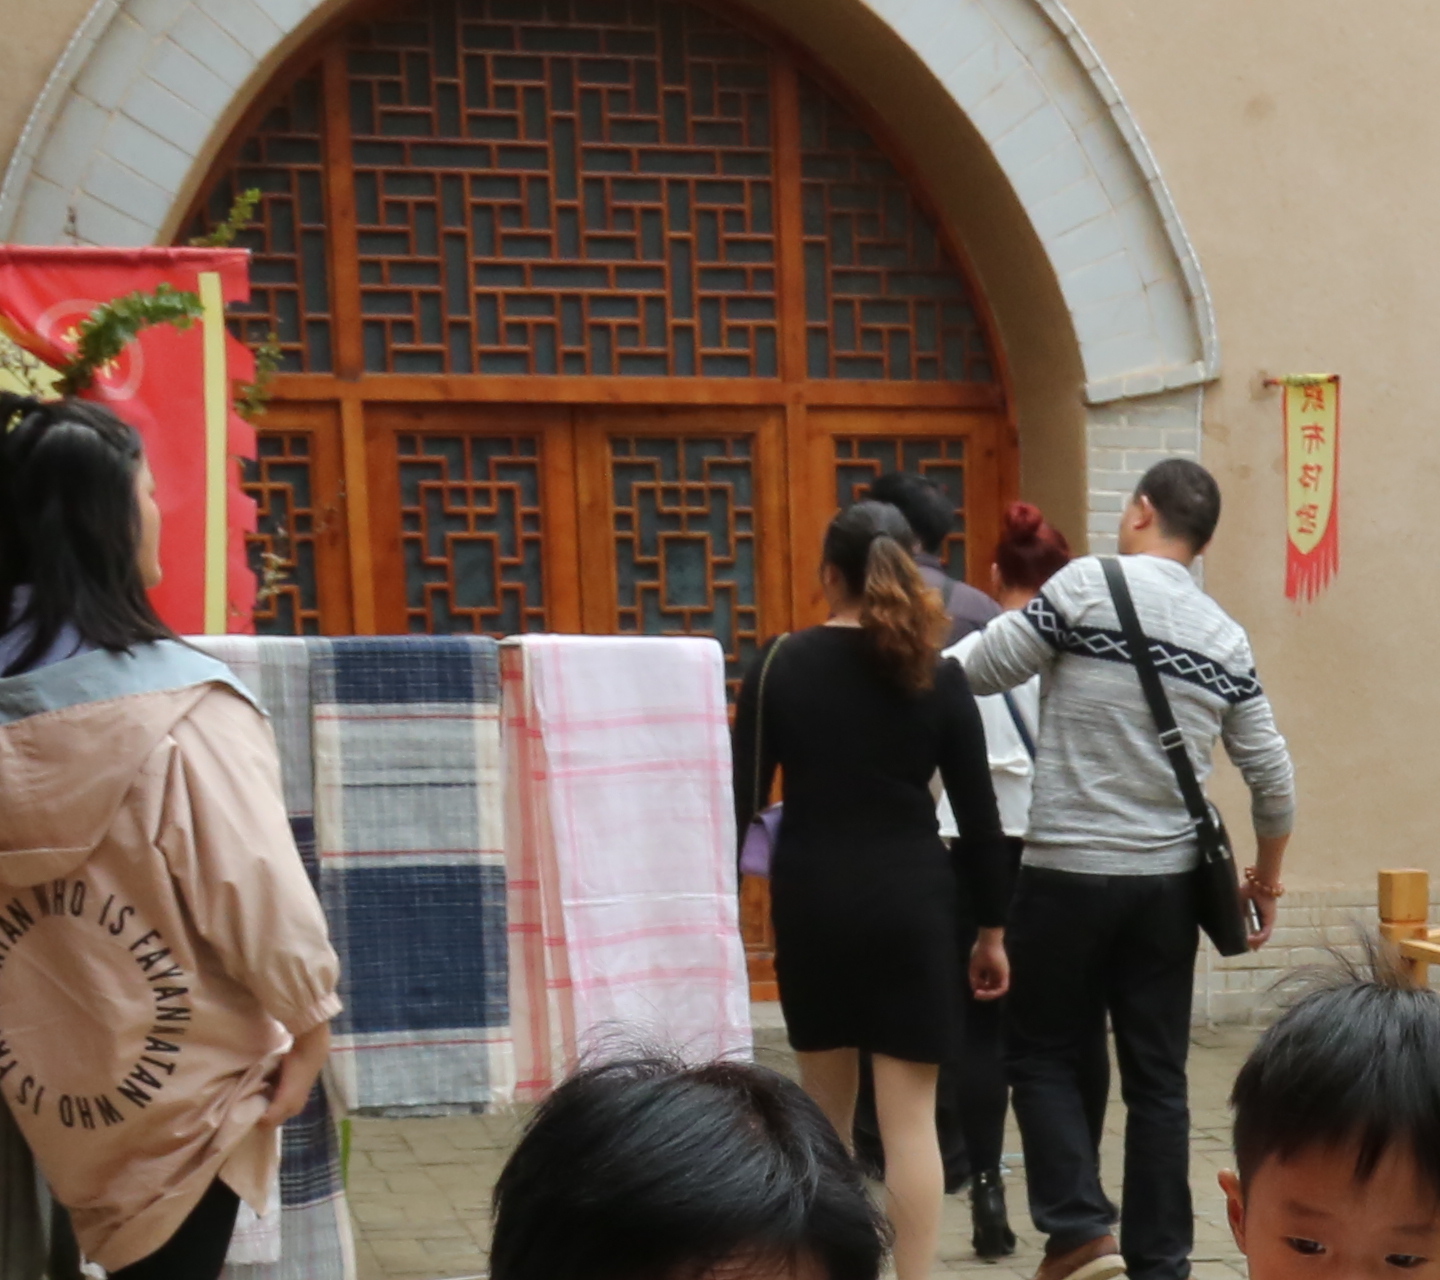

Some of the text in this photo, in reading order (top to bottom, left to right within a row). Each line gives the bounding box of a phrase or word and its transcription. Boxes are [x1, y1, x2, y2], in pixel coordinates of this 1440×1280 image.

[31, 879, 87, 917] WHO
[98, 893, 135, 936] IS
[15, 1074, 45, 1116] IS
[59, 1093, 126, 1130] WHO
